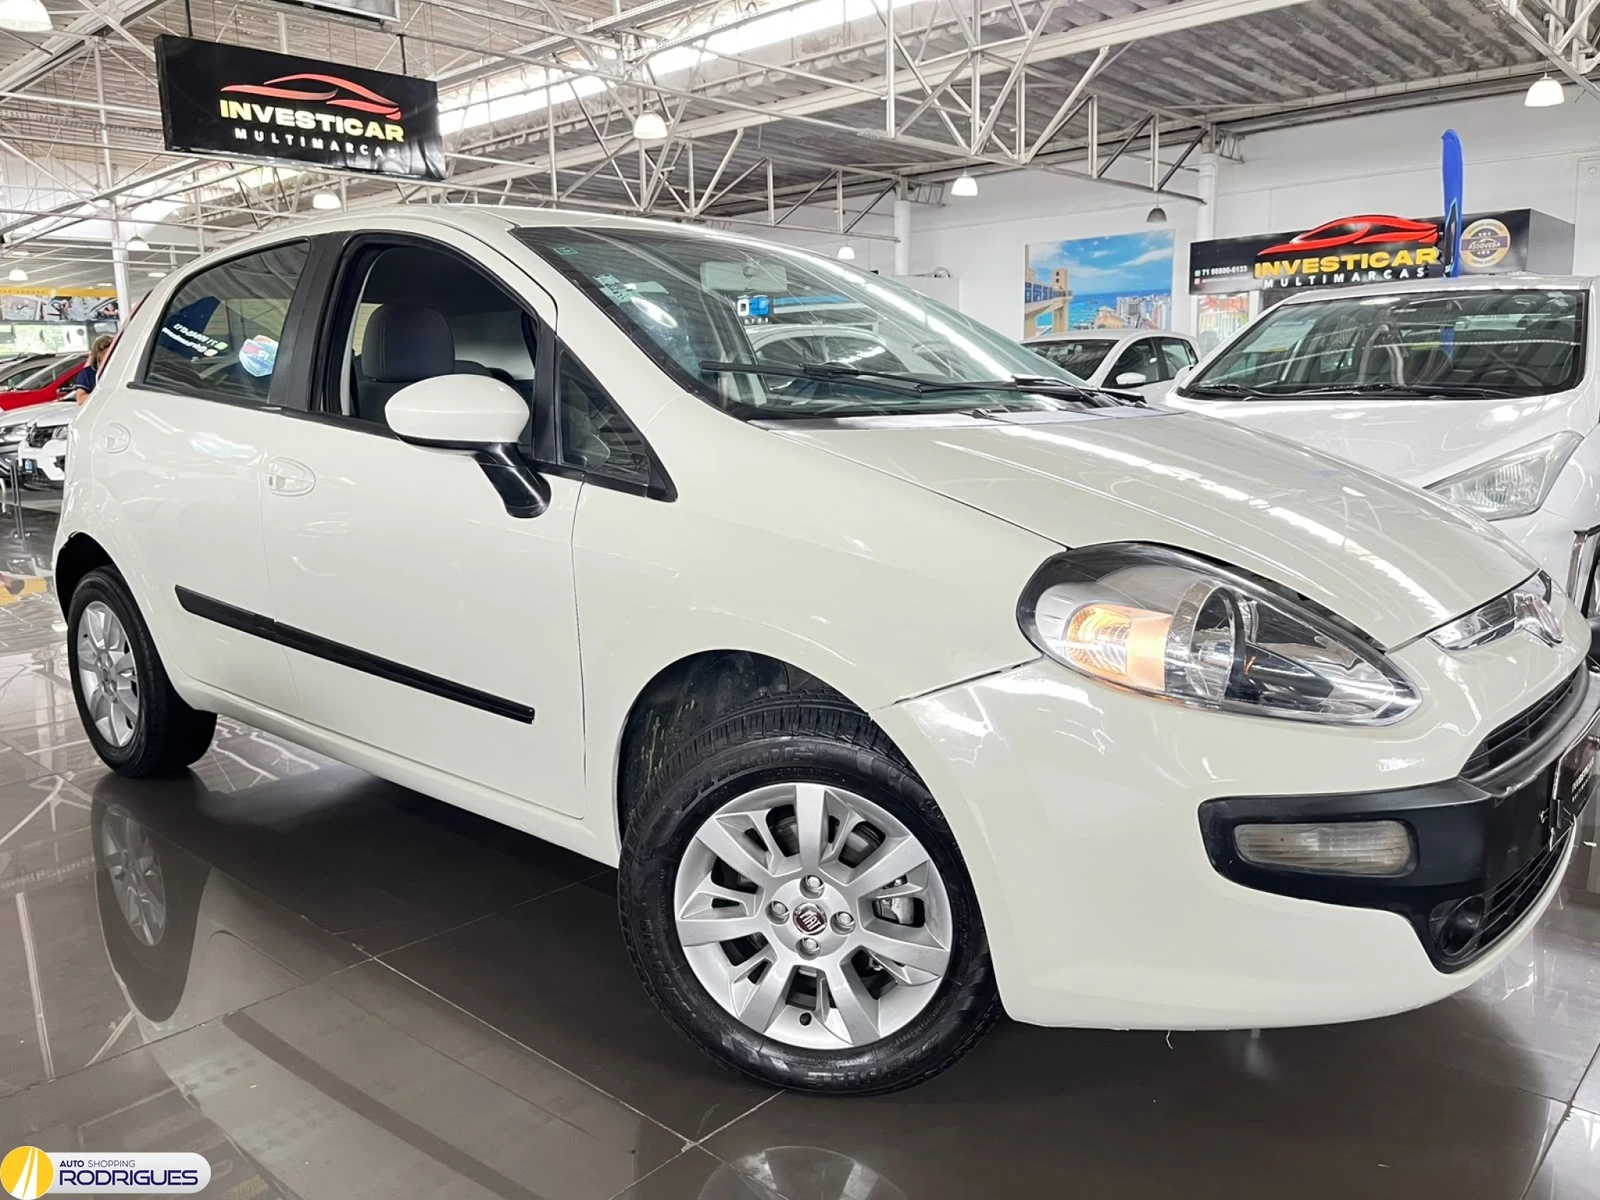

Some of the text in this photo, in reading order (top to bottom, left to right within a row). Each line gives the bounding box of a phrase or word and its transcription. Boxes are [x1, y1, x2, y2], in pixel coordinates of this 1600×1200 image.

[219, 99, 405, 143] INVESTICAR
[235, 128, 398, 160] MULTIMARCAS
[1254, 247, 1439, 279] INVESTICAR
[1263, 267, 1425, 289] MULTIMARCAS
